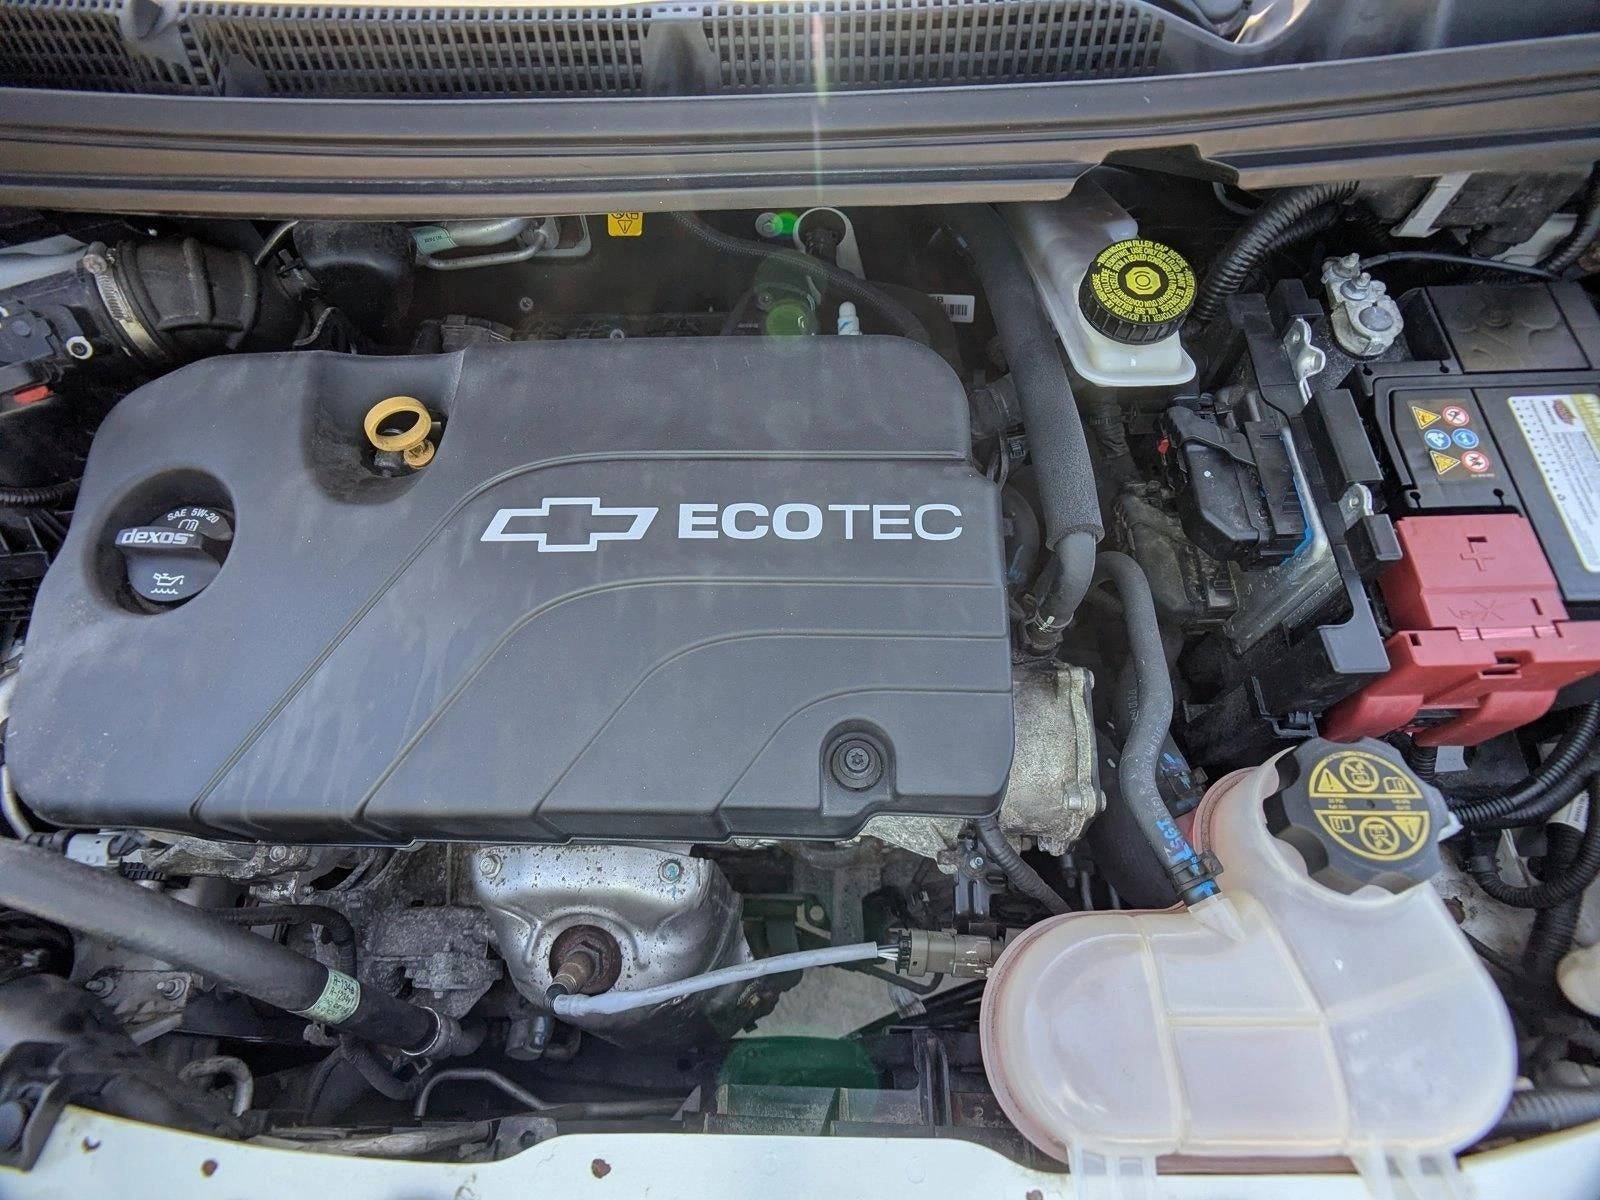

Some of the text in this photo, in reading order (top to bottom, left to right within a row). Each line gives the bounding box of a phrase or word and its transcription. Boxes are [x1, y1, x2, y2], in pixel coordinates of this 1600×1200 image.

[1132, 240, 1154, 248] FILLER
[1154, 243, 1169, 253] CAP
[166, 507, 220, 524] SAE 5W-20
[677, 502, 964, 541] ECOTEC
[122, 528, 194, 544] dexos
